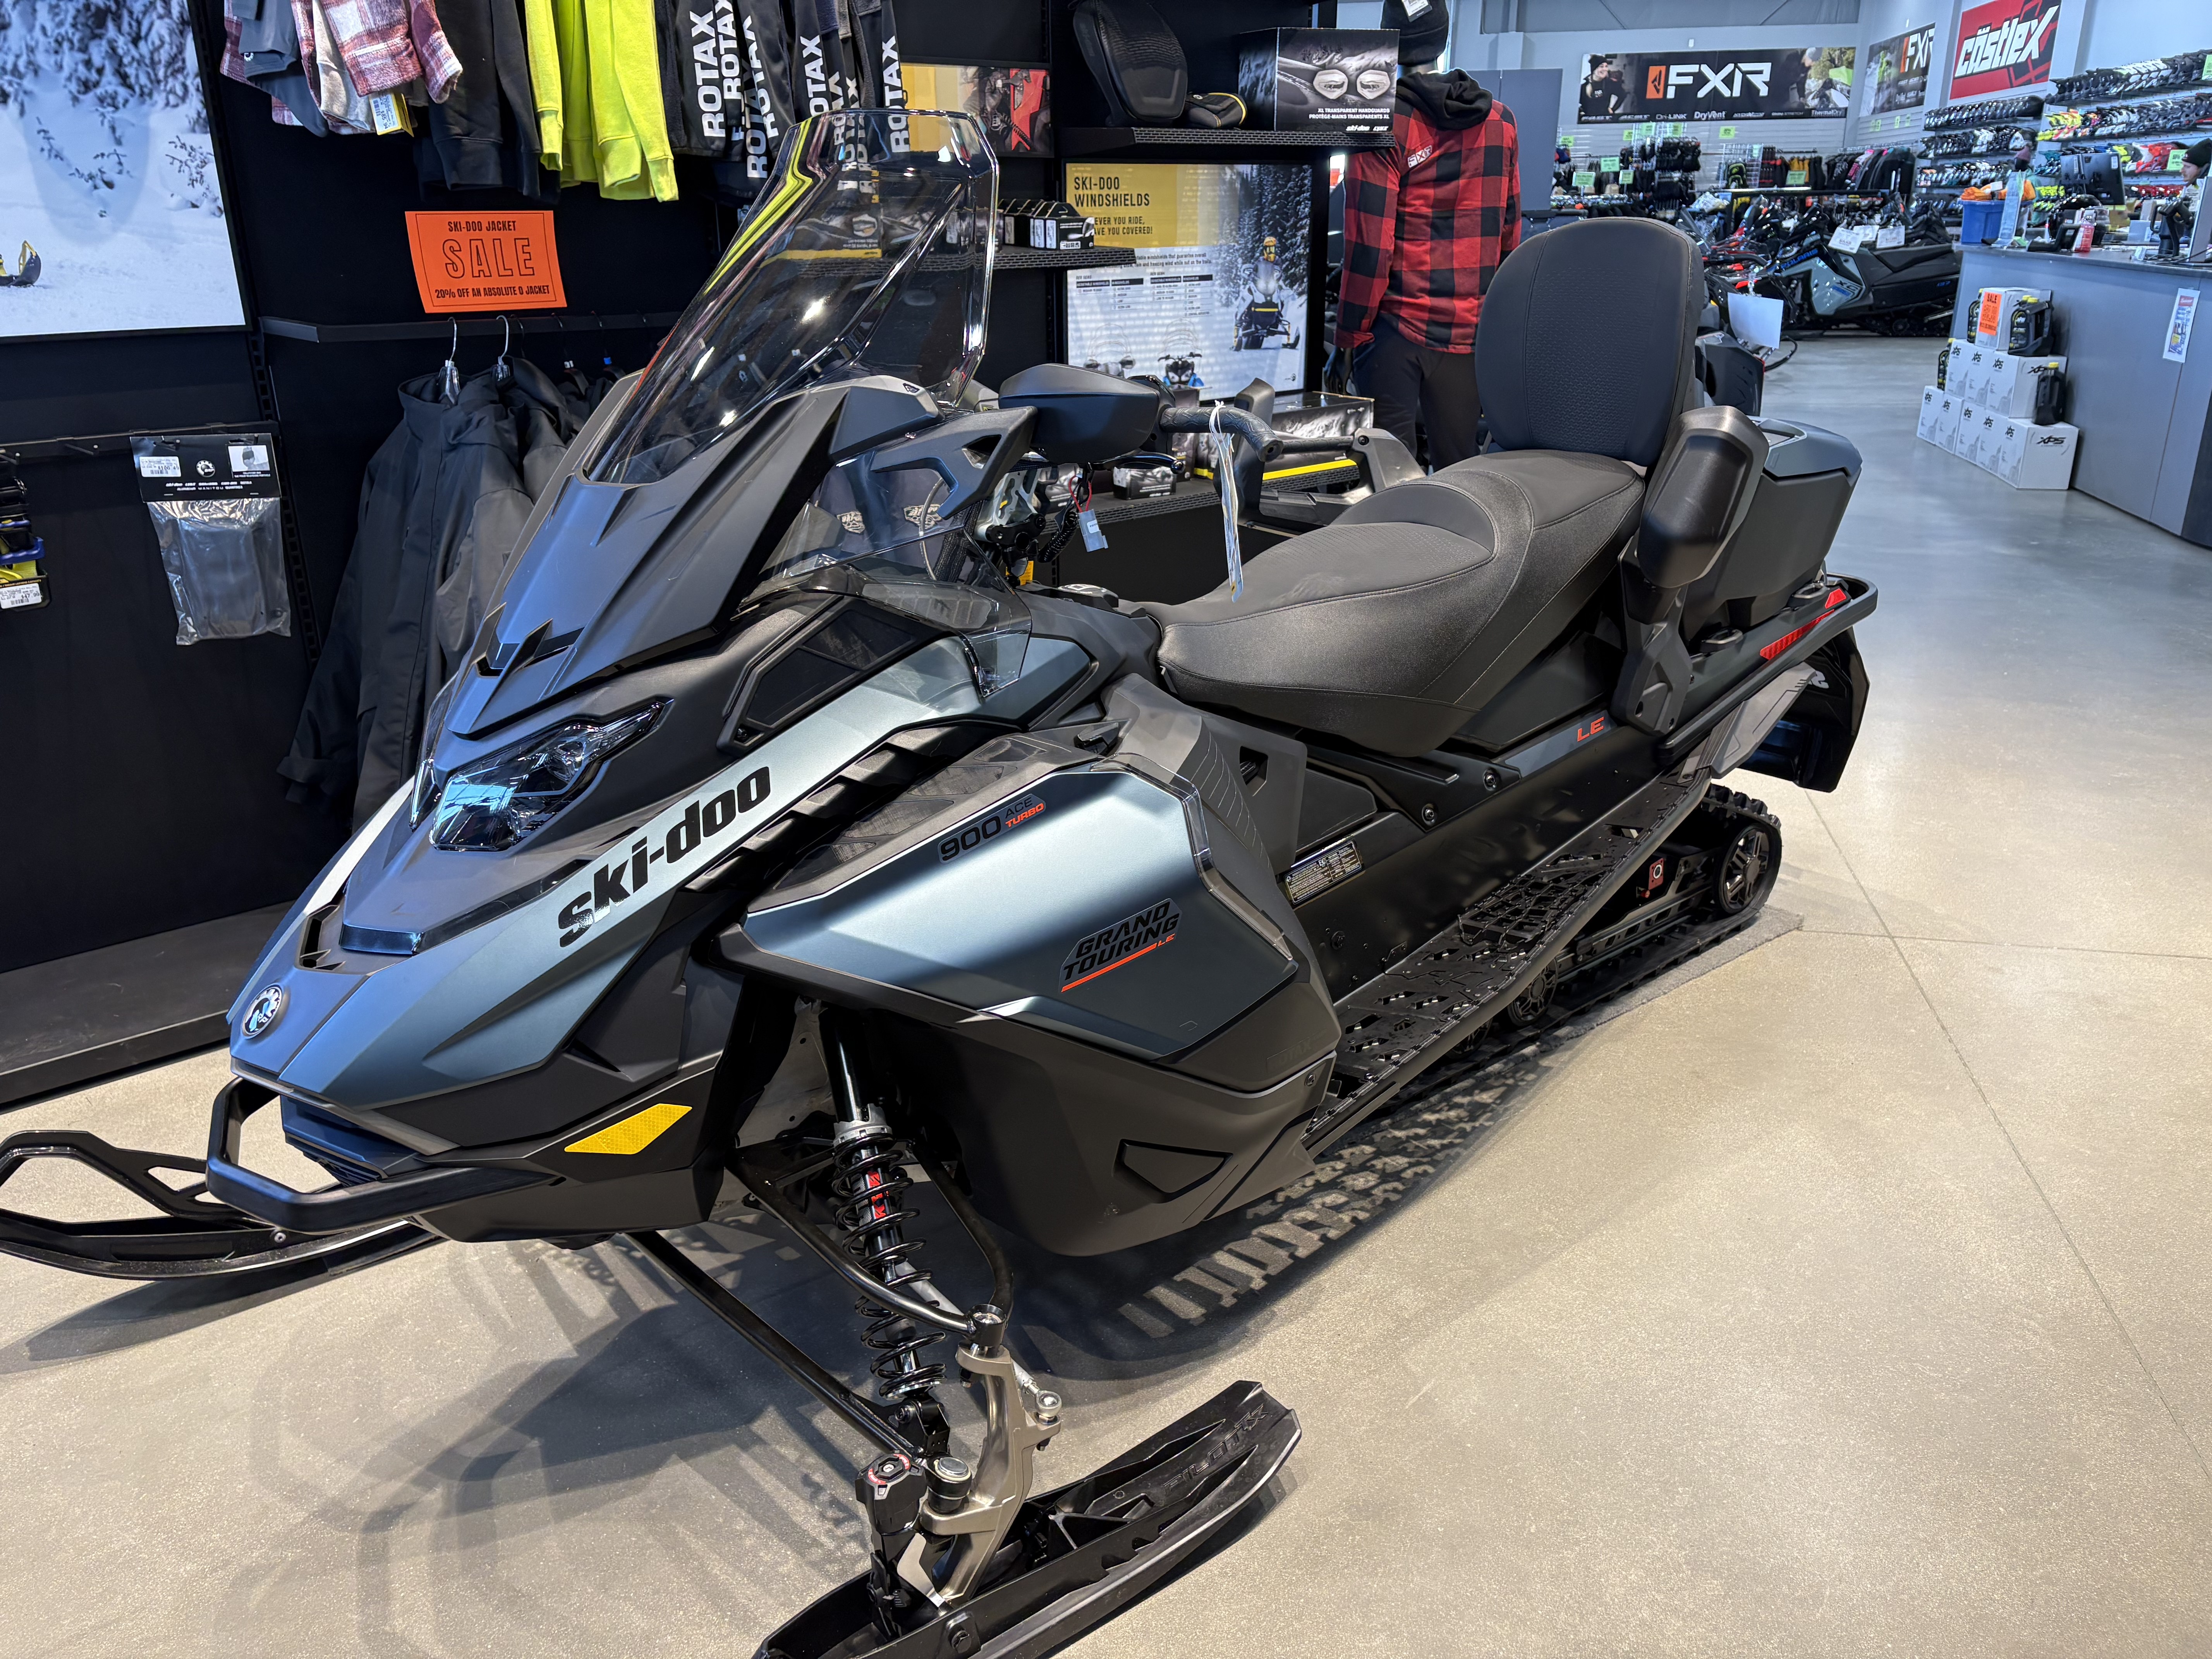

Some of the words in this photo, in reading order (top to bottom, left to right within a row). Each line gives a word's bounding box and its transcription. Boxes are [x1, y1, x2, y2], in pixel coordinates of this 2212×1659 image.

[690, 11, 725, 137] ROTAX
[800, 35, 830, 116] OTAX
[1667, 62, 1771, 99] FXR
[1074, 177, 1120, 191] SKI-DOO
[1074, 193, 1150, 207] WINDSHIELDS
[448, 221, 483, 232] SKI-DOO
[486, 220, 516, 232] JACKET
[1122, 226, 1152, 235] COVERED!
[1128, 216, 1145, 225] RIDE,
[443, 237, 535, 279] SALE
[435, 289, 456, 298] 20%
[457, 288, 469, 297] OFF
[472, 287, 481, 297] AN
[484, 286, 517, 297] ABSOLUTE
[526, 285, 550, 295] JACKET
[1987, 293, 1997, 304] SALE
[2027, 364, 2049, 374] XP
[1577, 716, 1604, 742] LE
[1005, 802, 1044, 827] TURBO
[1006, 797, 1033, 819] ACE
[939, 814, 1001, 862] 900
[558, 766, 771, 948] ski-doo
[1075, 901, 1171, 959] GRAND
[1157, 933, 1176, 948] LE
[1064, 913, 1180, 981] TOURING
[1163, 1429, 1240, 1496] PILOT
[1234, 1403, 1269, 1431] TX
